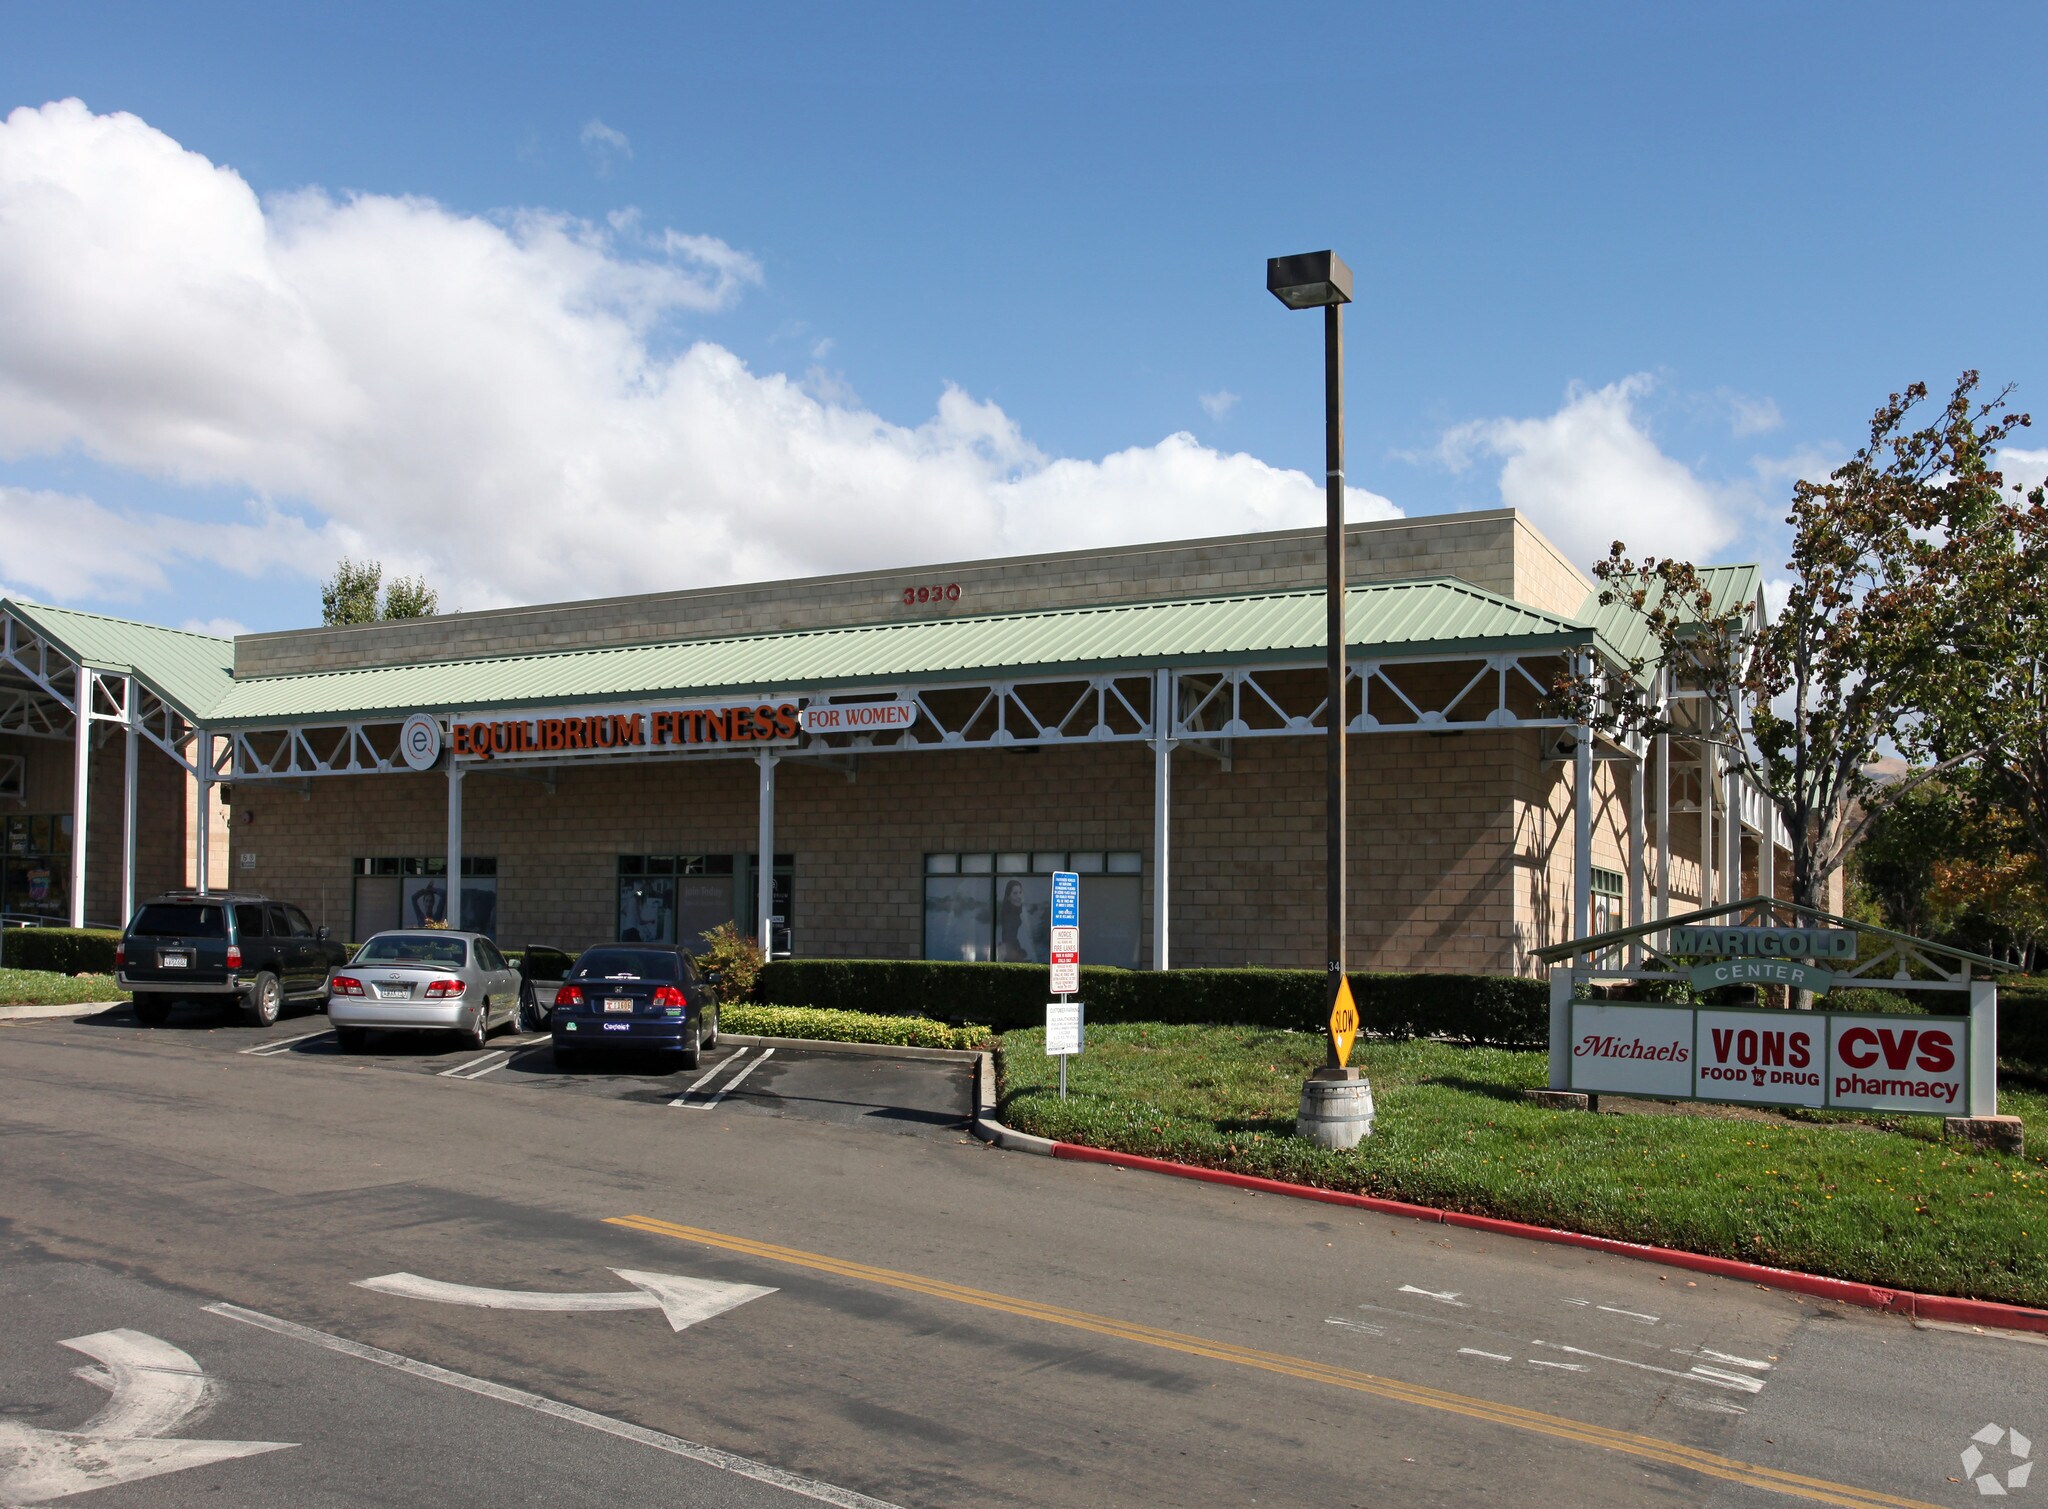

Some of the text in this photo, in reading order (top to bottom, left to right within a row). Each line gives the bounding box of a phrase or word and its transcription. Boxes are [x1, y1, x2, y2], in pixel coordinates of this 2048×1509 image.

[903, 583, 962, 606] 3930
[807, 705, 910, 729] FOR WOMEN
[453, 703, 797, 759] EQUILIBRIUM FITNESS
[1672, 929, 1856, 957] MARIGOLD
[1328, 961, 1341, 972] 34
[1715, 964, 1805, 983] CENTER
[1335, 1009, 1353, 1033] SLOW
[1573, 1035, 1689, 1063] Michaels
[1711, 1028, 1811, 1069] VONS
[1838, 1027, 1956, 1073] CVS
[1701, 1066, 1748, 1082] FOOD
[1770, 1071, 1820, 1087] DRUG
[1835, 1073, 1960, 1104] pharmacy
[1581, 1234, 1651, 1249] PARKING
